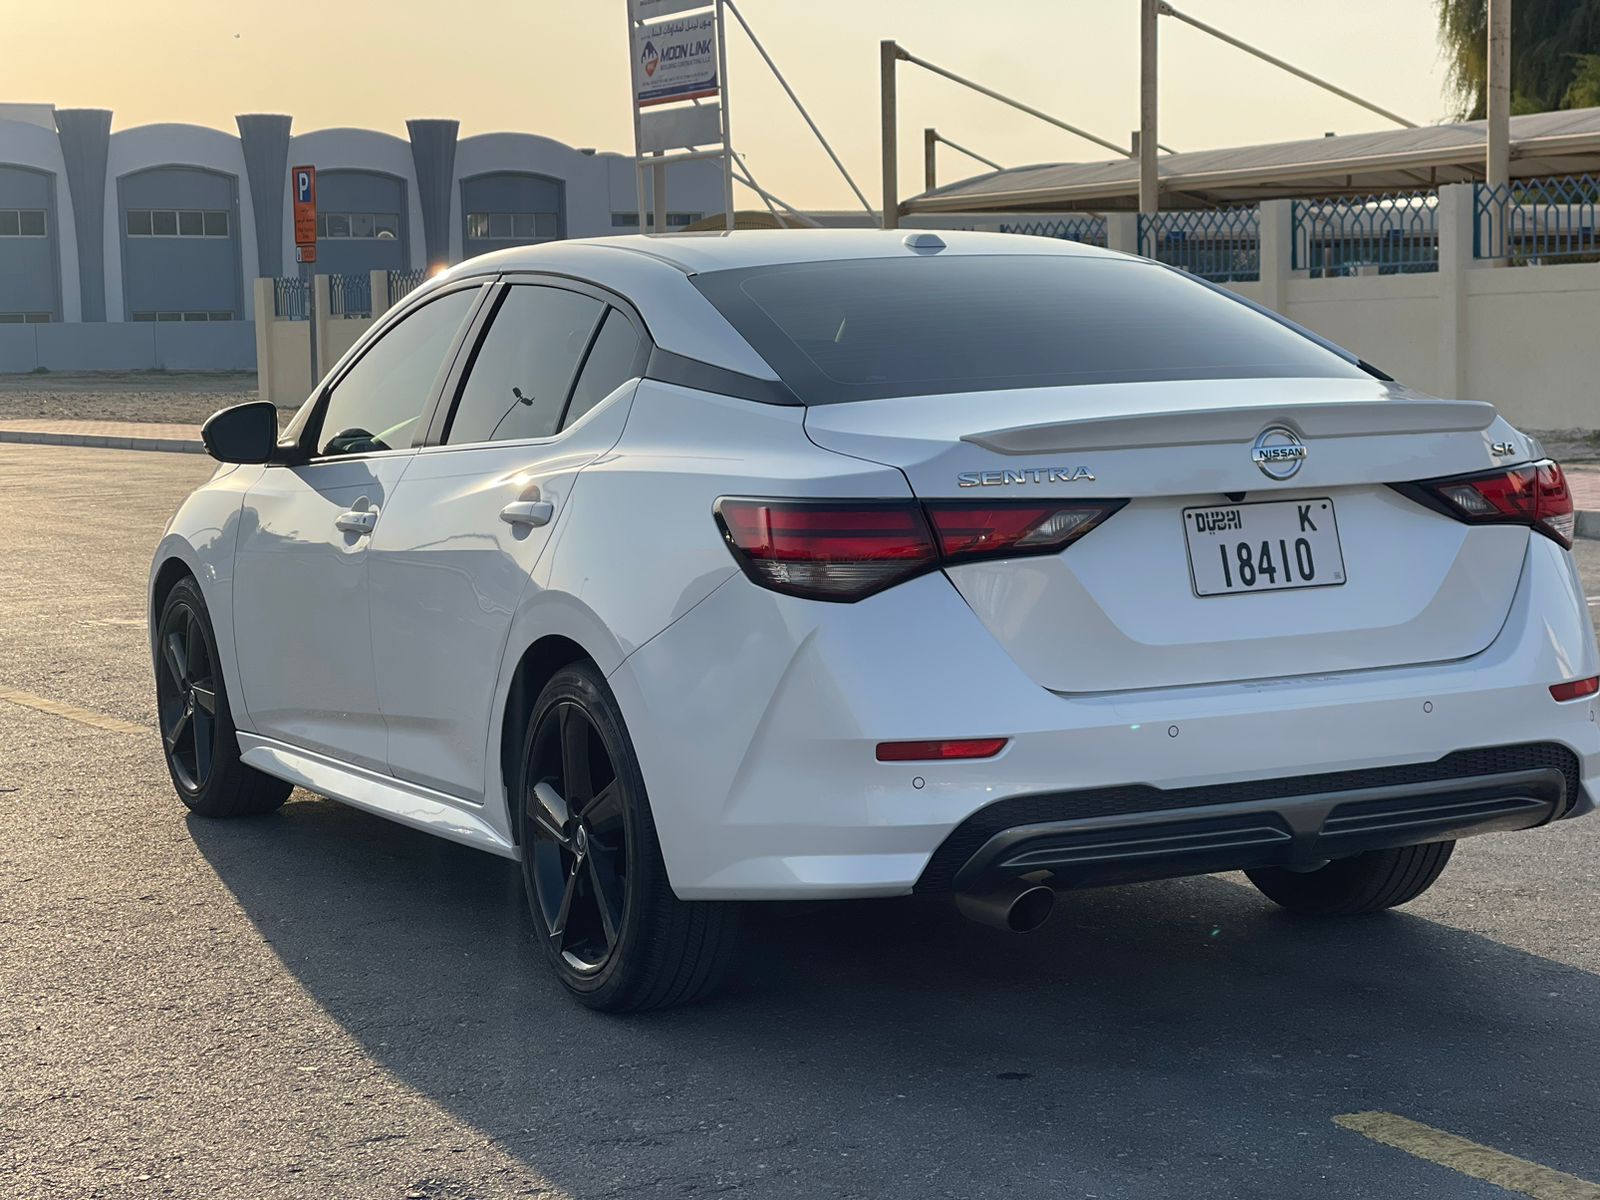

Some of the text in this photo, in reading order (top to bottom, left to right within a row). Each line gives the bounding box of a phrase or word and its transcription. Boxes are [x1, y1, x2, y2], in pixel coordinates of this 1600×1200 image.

[660, 39, 712, 62] MOON LINK
[298, 172, 309, 201] P
[1259, 447, 1303, 459] NISSAN
[957, 465, 1096, 487] SENTRA
[1298, 505, 1317, 532] K
[1219, 537, 1315, 588] 18410
